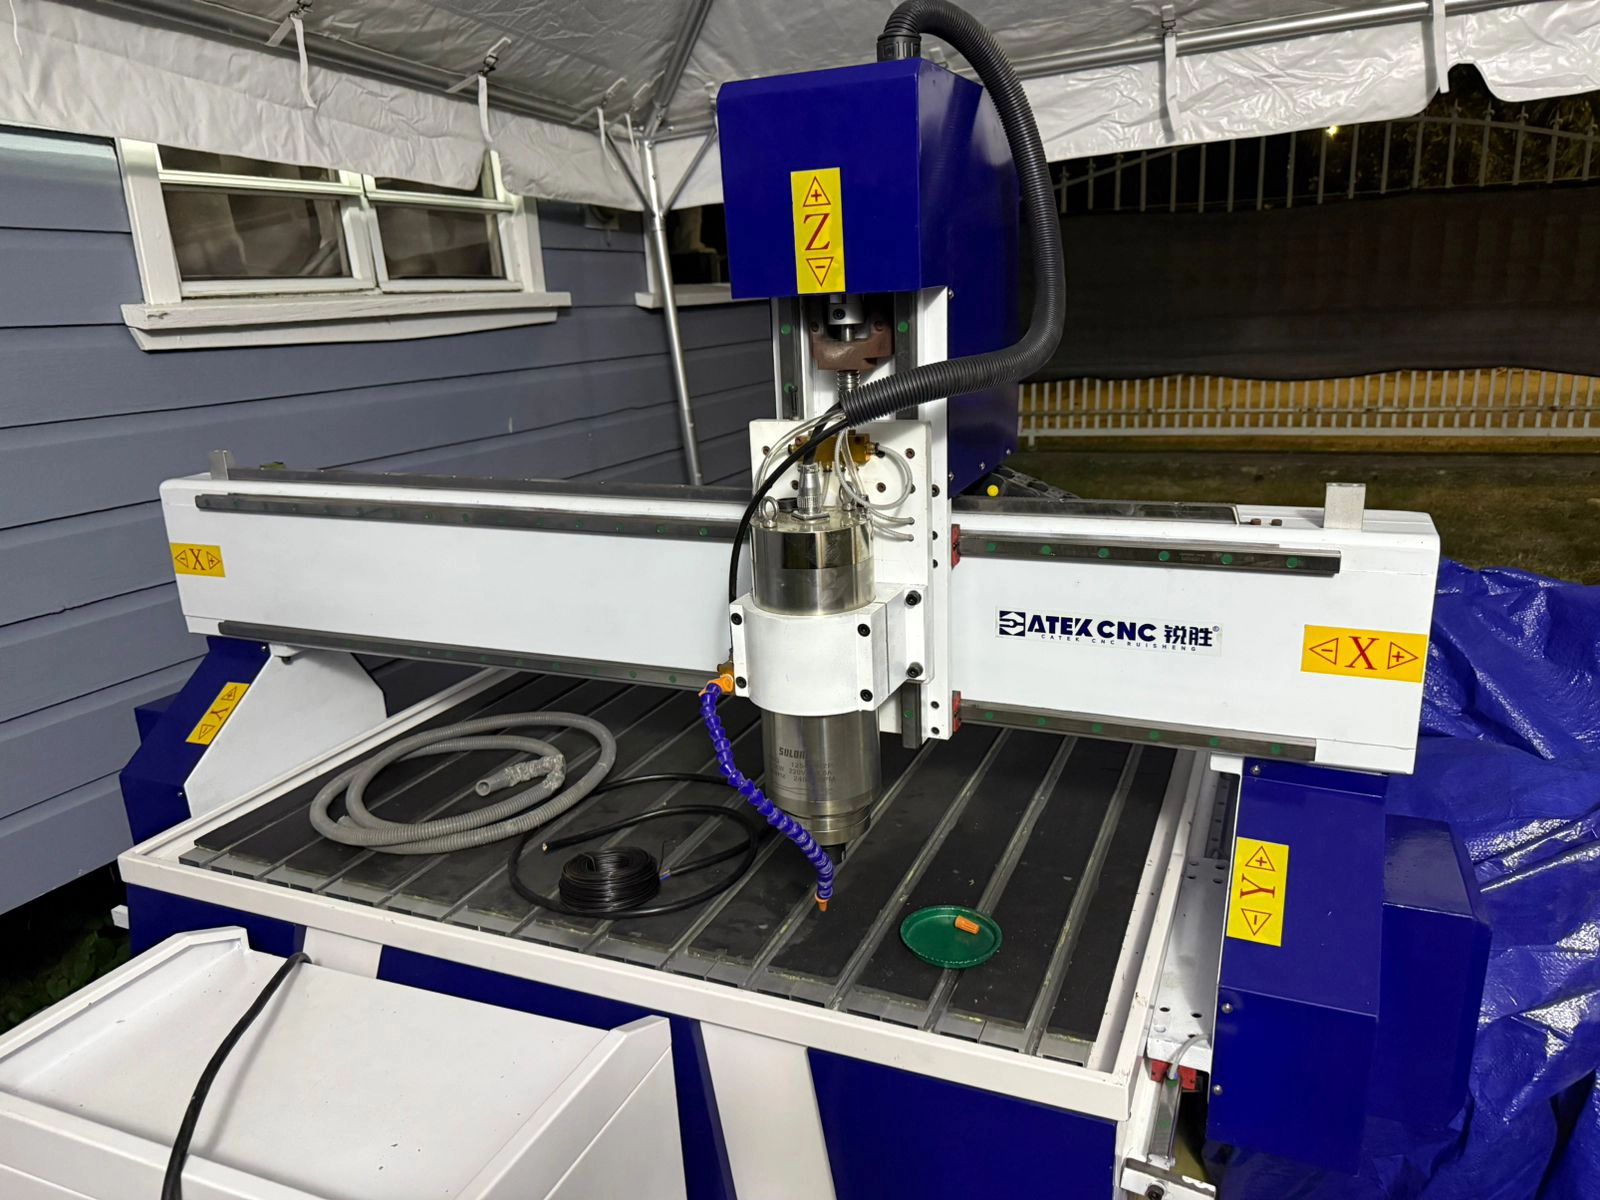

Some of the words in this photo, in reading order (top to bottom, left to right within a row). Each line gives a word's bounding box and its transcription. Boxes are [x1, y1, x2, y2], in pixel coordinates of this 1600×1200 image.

[803, 213, 830, 251] Z
[188, 548, 206, 571] X
[1041, 633, 1080, 642] CATEK
[1126, 641, 1196, 652] RUISHENG
[1097, 620, 1157, 642] CNC
[1344, 635, 1380, 670] X
[209, 706, 230, 721] Y
[1240, 873, 1276, 899] Y
